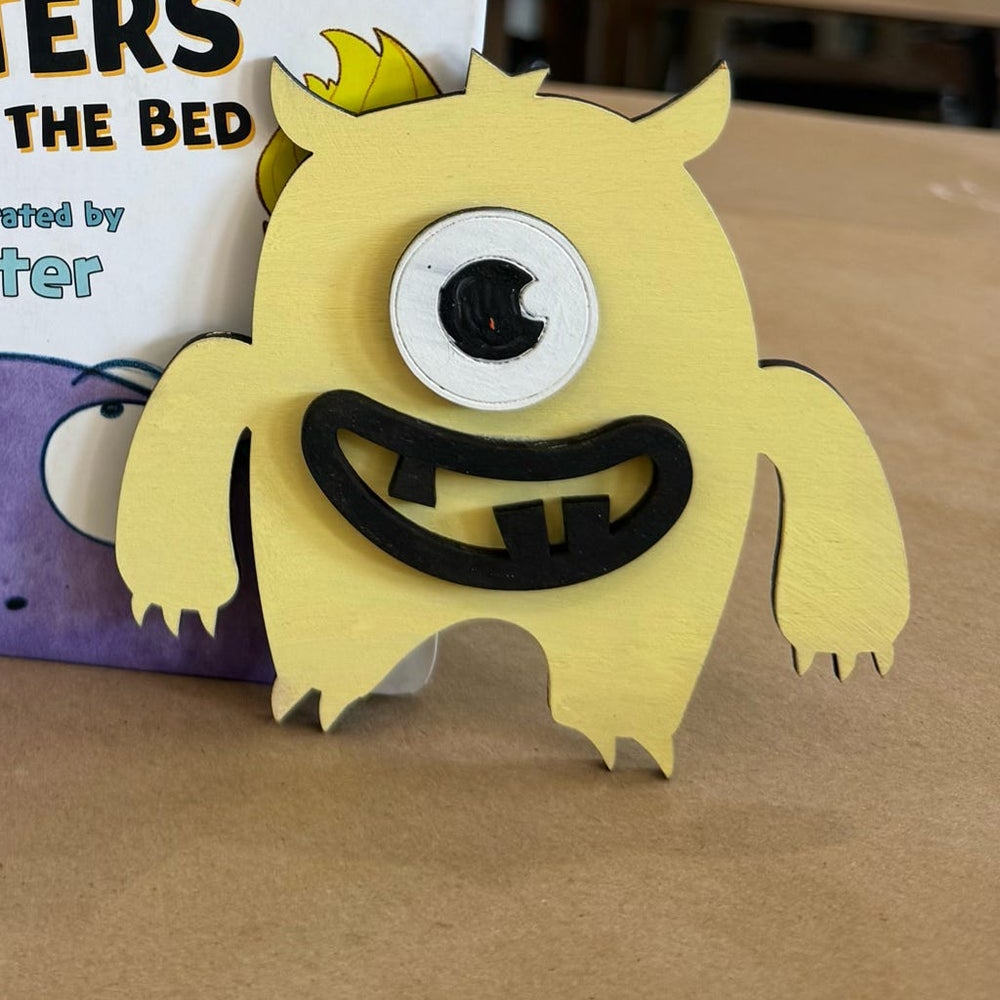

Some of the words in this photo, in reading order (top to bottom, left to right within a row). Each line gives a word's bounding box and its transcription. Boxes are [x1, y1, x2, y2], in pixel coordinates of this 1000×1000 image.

[4, 102, 118, 151] THE
[138, 98, 256, 151] BED
[84, 200, 125, 233] by
